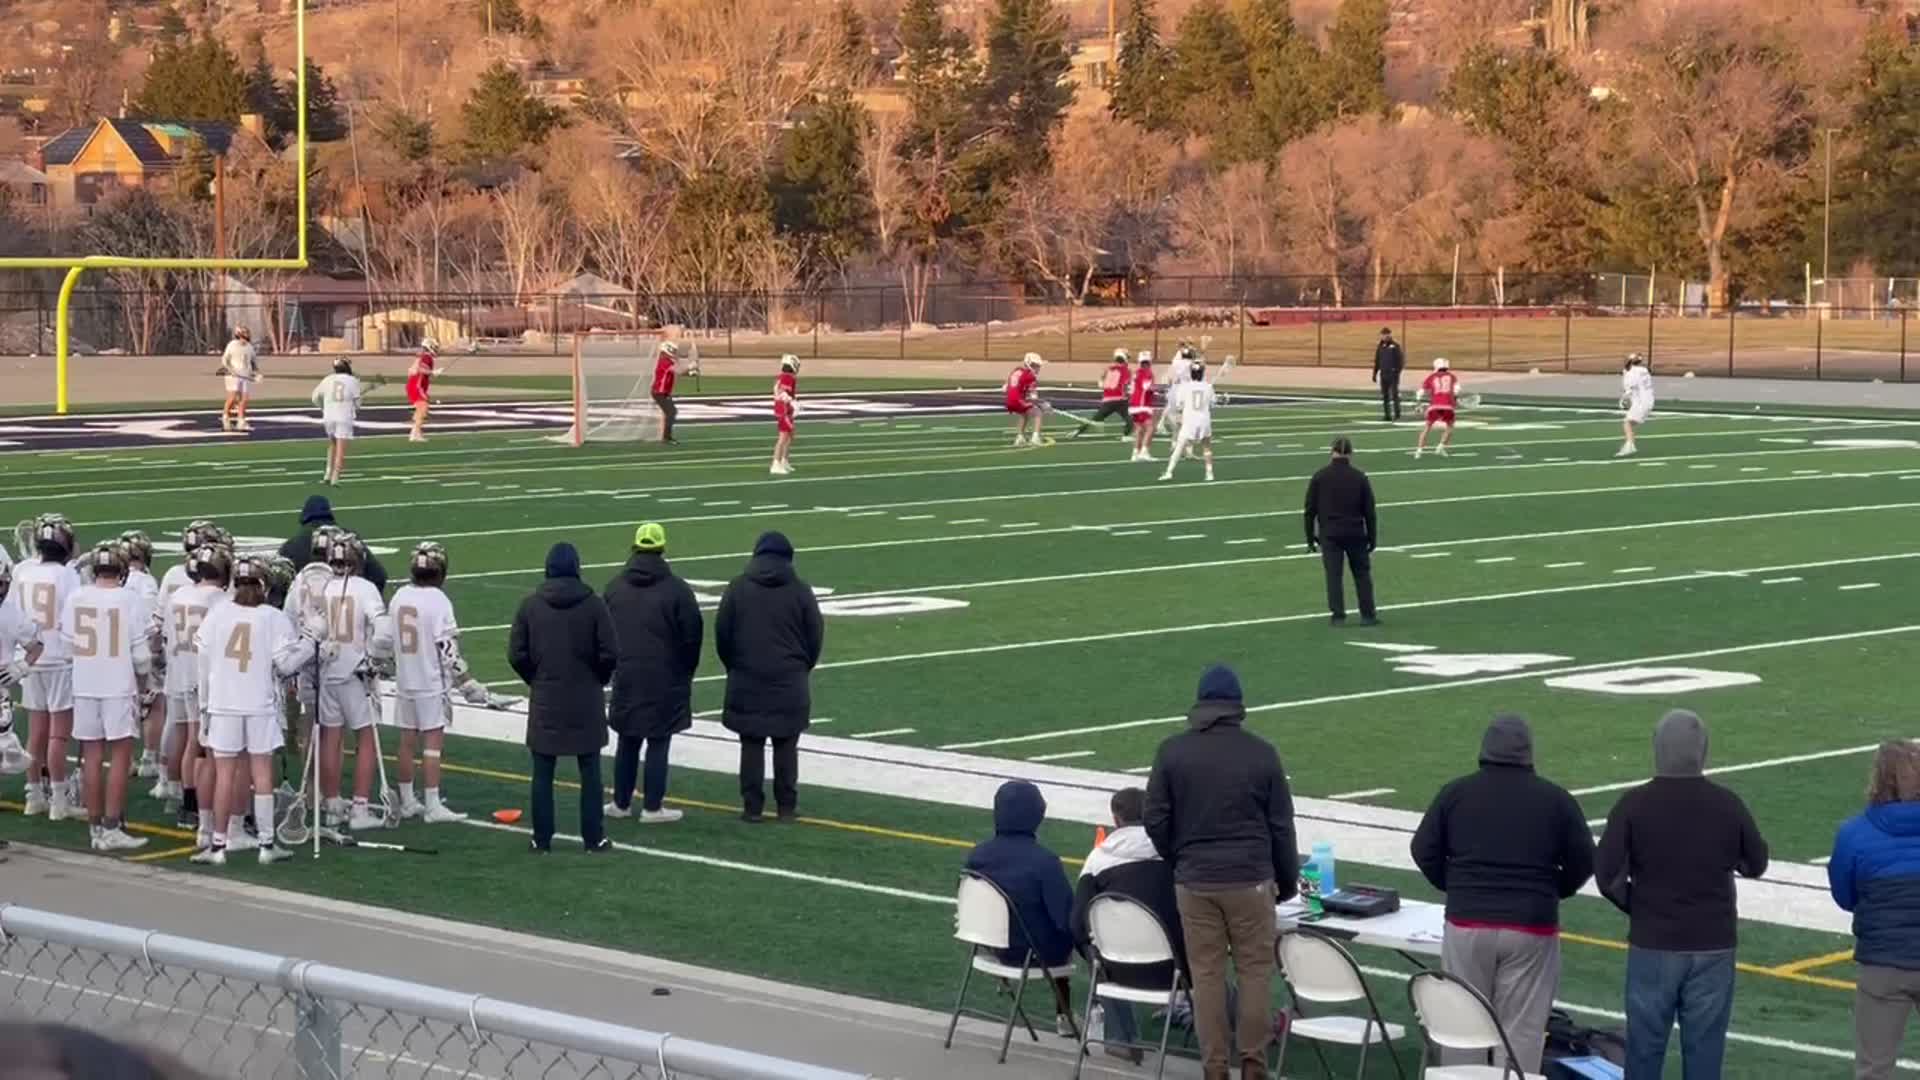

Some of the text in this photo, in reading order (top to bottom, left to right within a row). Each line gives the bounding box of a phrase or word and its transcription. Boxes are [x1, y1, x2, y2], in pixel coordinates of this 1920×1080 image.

[18, 582, 56, 630] 19
[398, 605, 418, 655] 6
[73, 606, 120, 658] 51
[224, 621, 253, 673] 4
